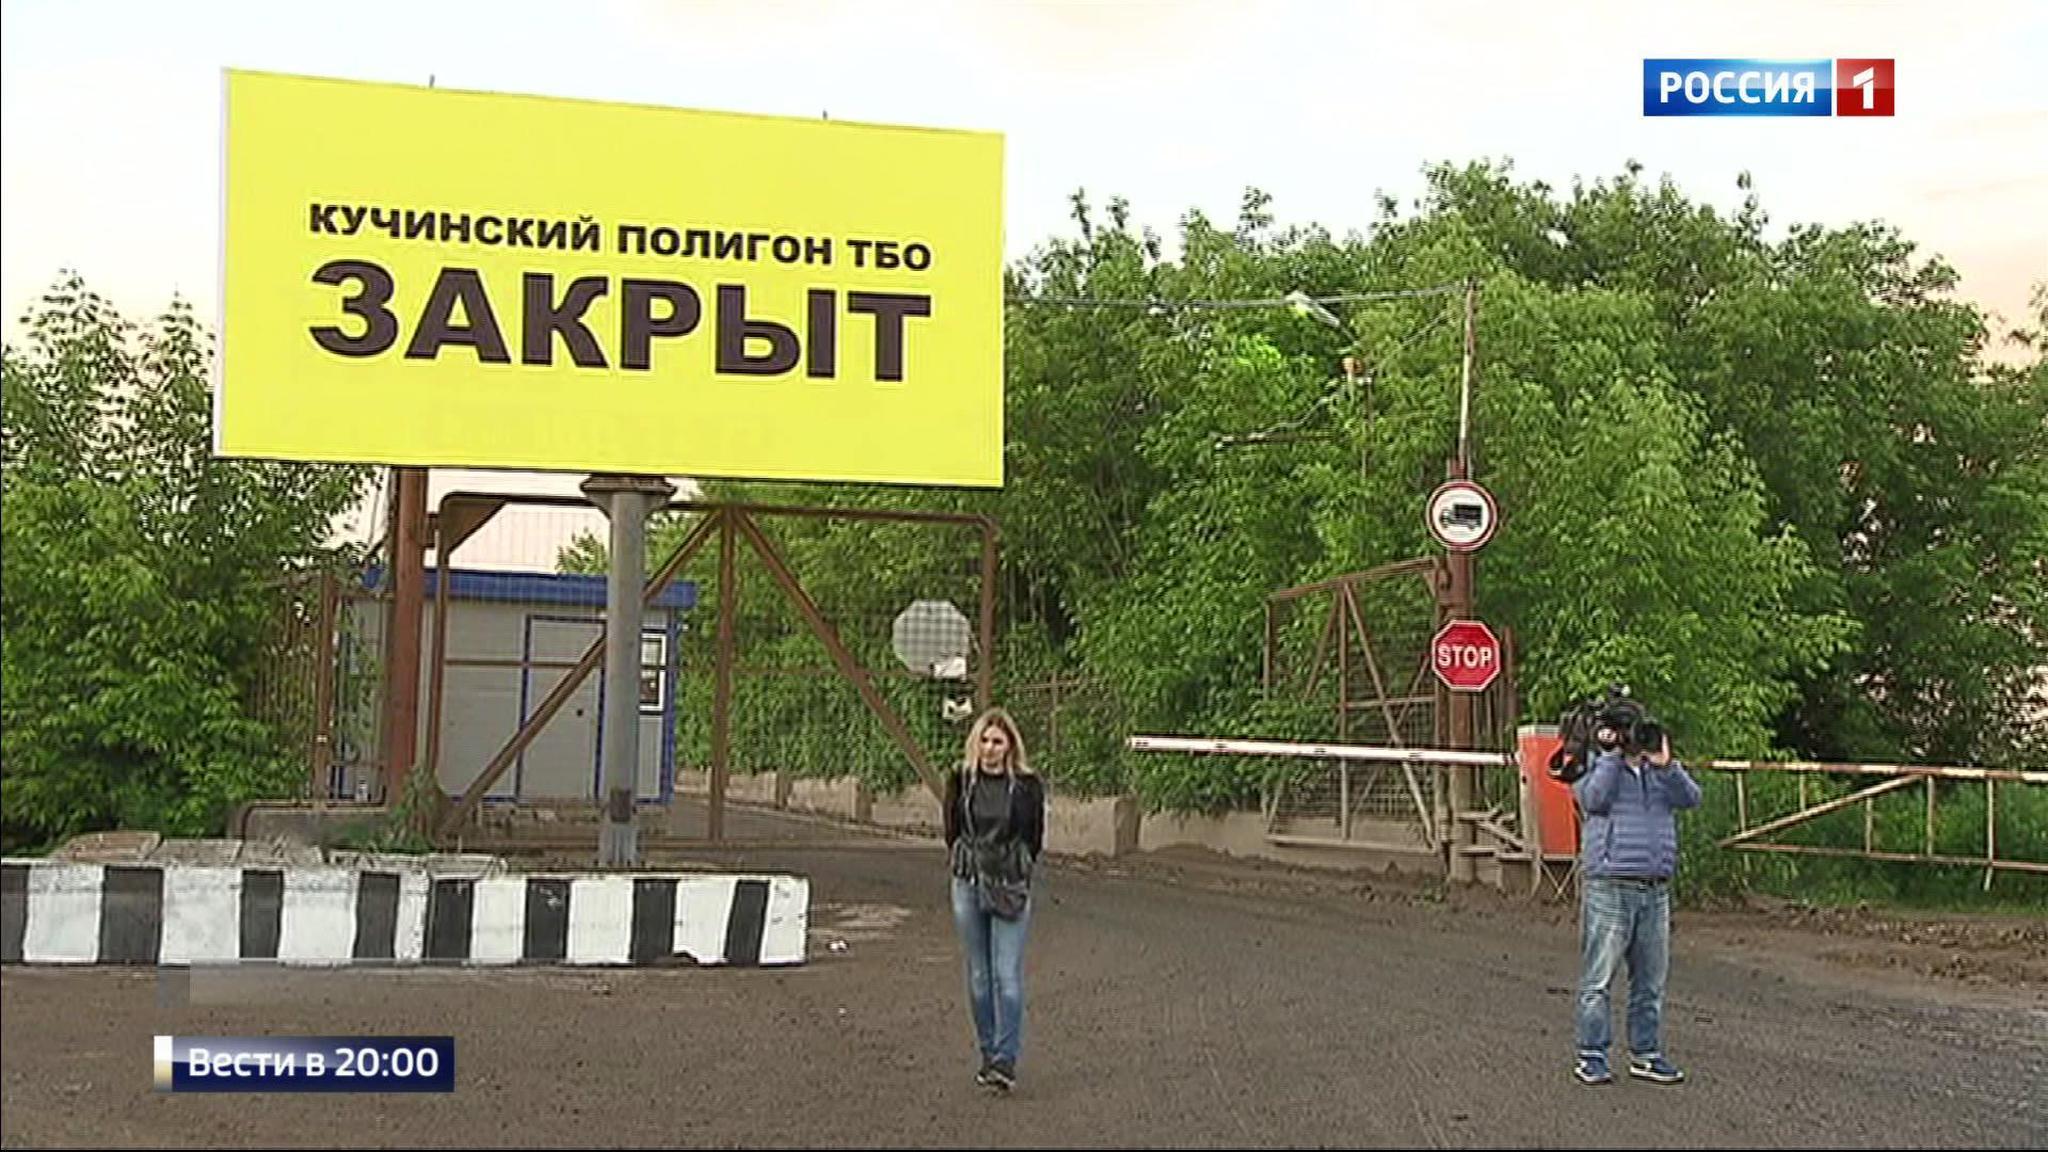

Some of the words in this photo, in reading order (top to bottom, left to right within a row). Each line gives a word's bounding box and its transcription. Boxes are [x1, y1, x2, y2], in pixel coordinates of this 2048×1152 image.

[309, 203, 601, 252] КУЧИНСКИЙ
[617, 224, 832, 265] ПОЛИГОН
[846, 239, 931, 272] ТБО
[308, 258, 932, 383] ЗАКРЫТ
[1437, 645, 1493, 668] STOP
